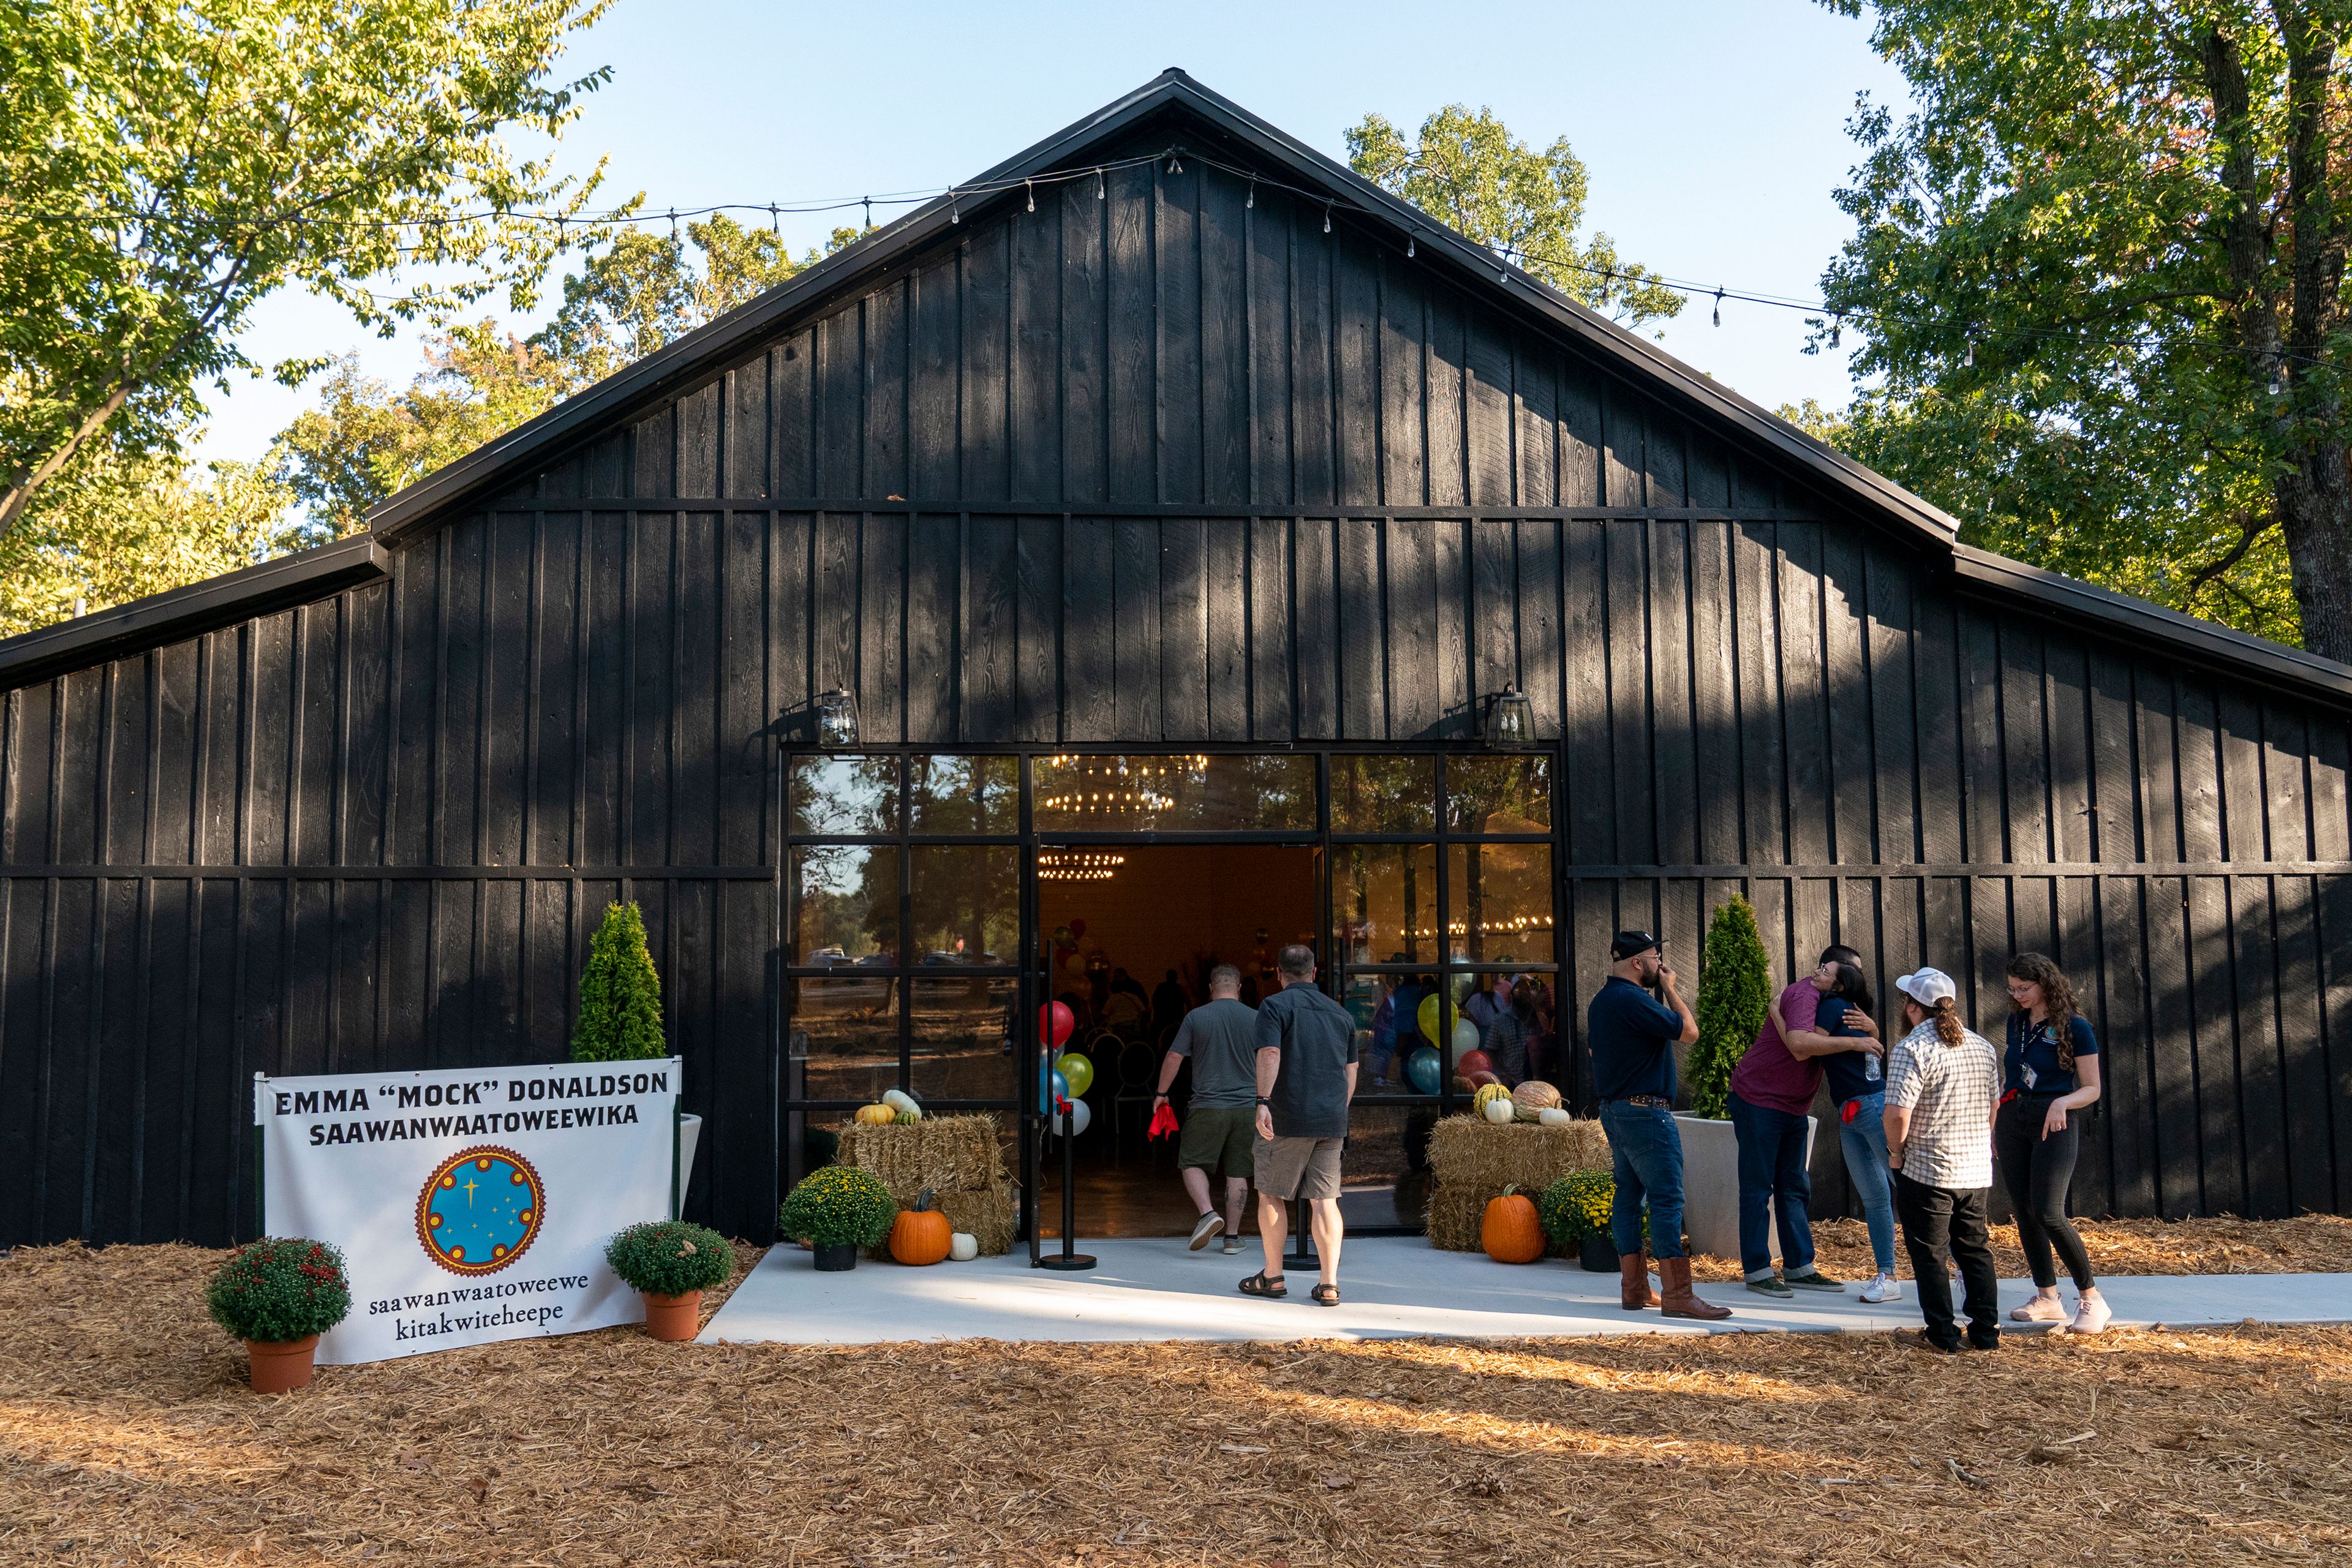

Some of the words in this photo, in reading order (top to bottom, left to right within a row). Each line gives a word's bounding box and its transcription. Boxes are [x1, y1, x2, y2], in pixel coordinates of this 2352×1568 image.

[276, 1088, 370, 1116] EMMA
[379, 1080, 498, 1109] “MOCK”
[509, 1072, 668, 1102] DONALDSON
[309, 1104, 639, 1146] SAAWANWAATOWEEWIKA
[369, 1275, 589, 1315] saawanwaatoweewe
[395, 1303, 564, 1341] kitakwiteheepe
